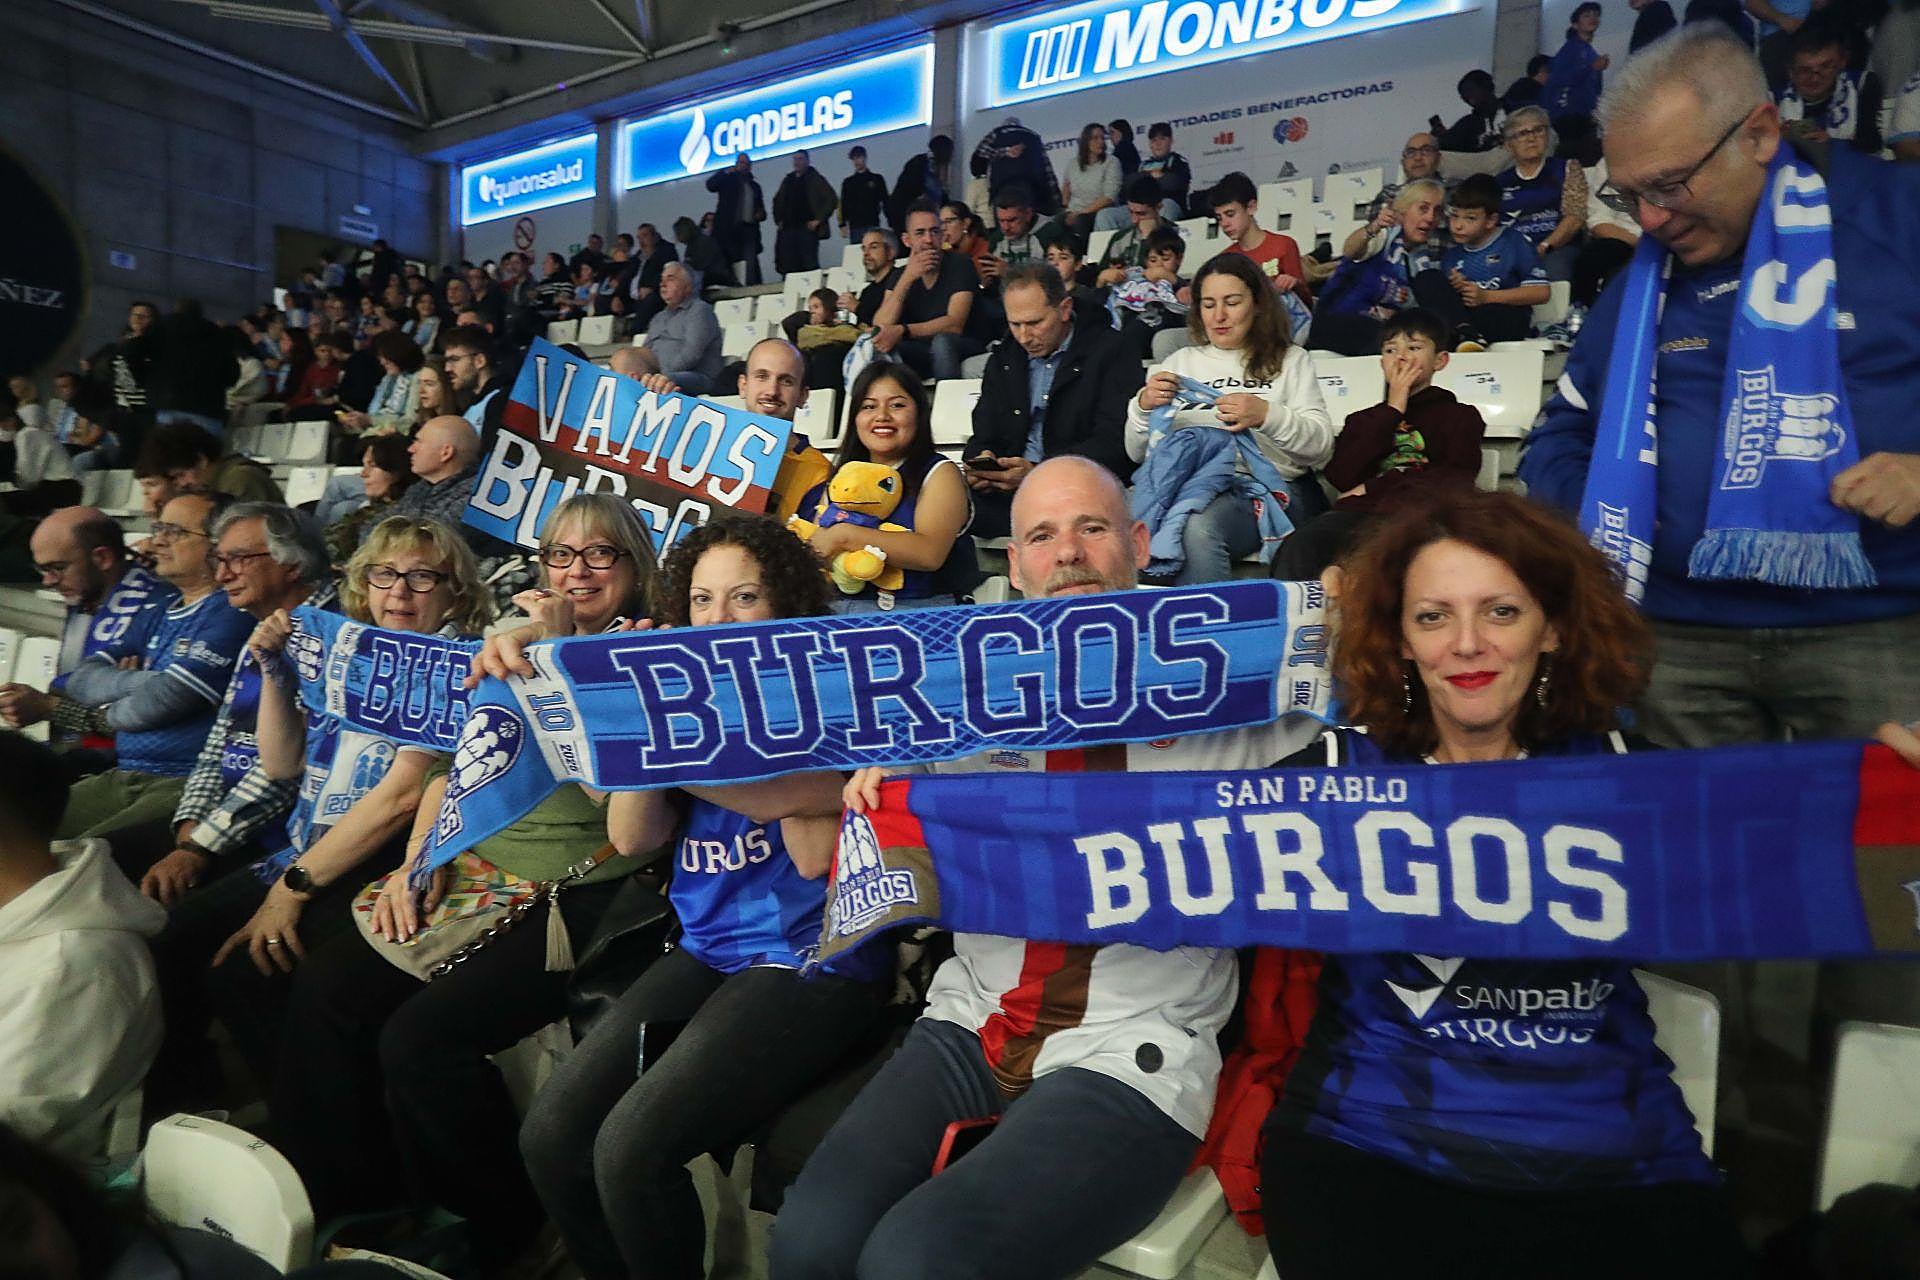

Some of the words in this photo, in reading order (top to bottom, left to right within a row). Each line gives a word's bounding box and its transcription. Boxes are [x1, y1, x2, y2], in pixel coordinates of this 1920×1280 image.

[712, 90, 853, 156] CANDELAS
[1167, 108, 1242, 129] TIDADES
[1247, 81, 1394, 116] BENEFACTORAS
[535, 356, 778, 507] VAMOS
[1730, 375, 1769, 483] BURGOS
[360, 636, 474, 740] BUR
[526, 691, 576, 732] 10
[608, 593, 1231, 771] BURGOS
[1294, 681, 1312, 706] 2015
[1216, 776, 1285, 808] SAN
[1298, 776, 1408, 804] PABLO
[838, 874, 911, 923] URGOS
[1072, 810, 1629, 942] BURGOS
